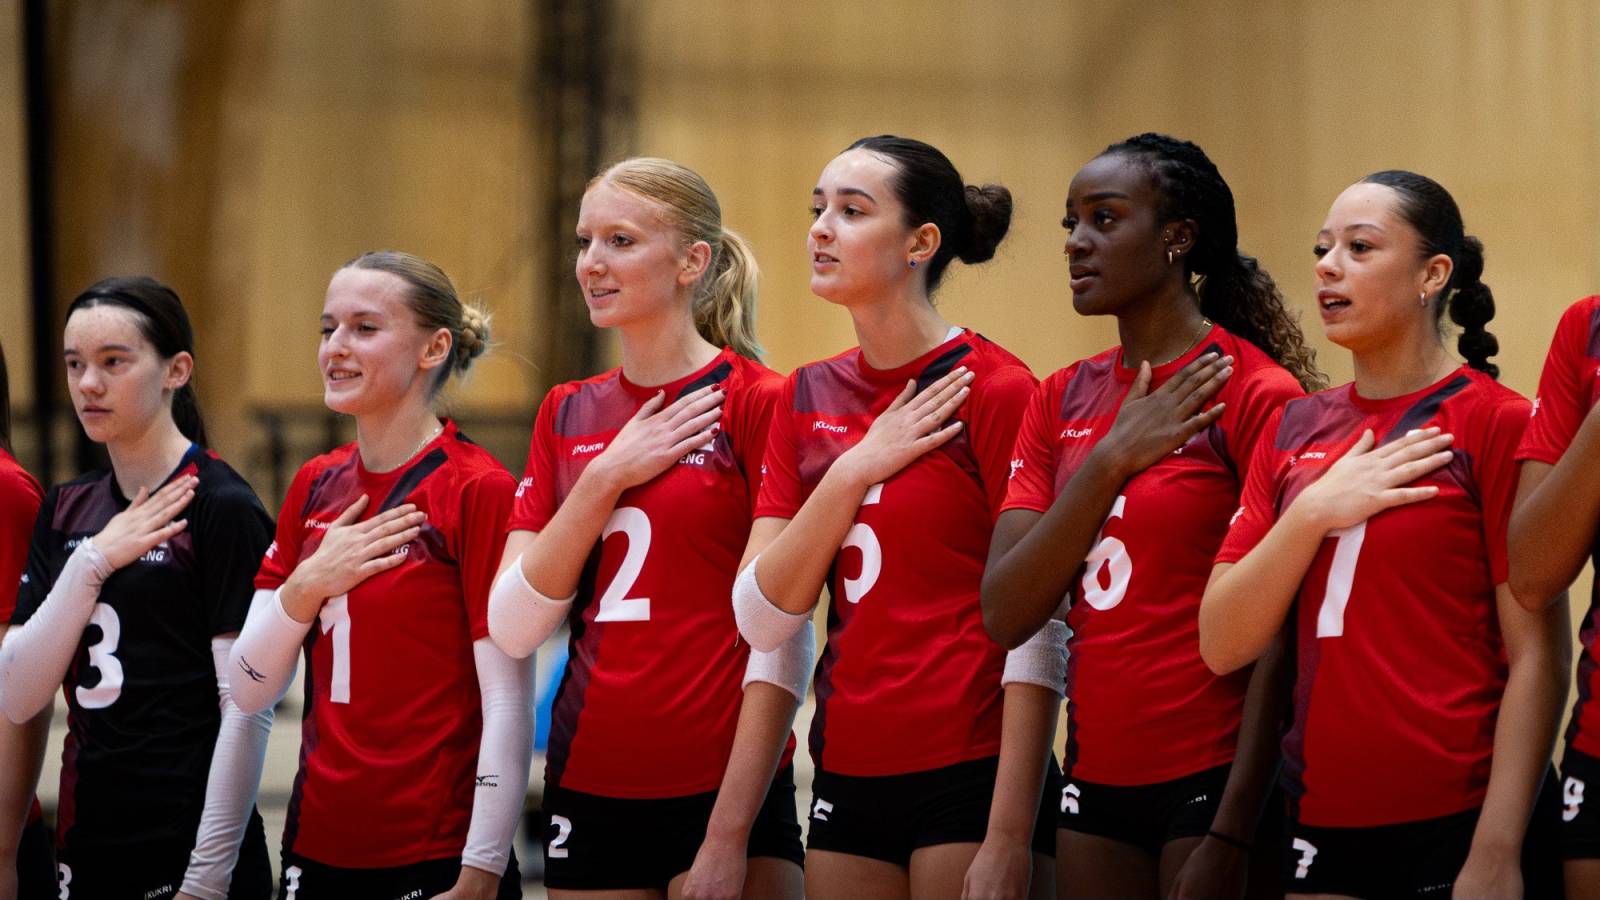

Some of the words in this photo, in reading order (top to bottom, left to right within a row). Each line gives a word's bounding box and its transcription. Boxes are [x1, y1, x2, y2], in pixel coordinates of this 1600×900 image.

[576, 442, 604, 454] KUKRI
[816, 420, 848, 433] KUKRI
[594, 506, 652, 623] 2
[841, 483, 883, 604] 5
[1082, 494, 1133, 611] 6
[1315, 520, 1367, 638] 7
[75, 602, 124, 708] 3
[319, 591, 351, 704] 1
[548, 814, 572, 858] 2
[1562, 776, 1585, 821] 9
[1292, 837, 1318, 878] 7
